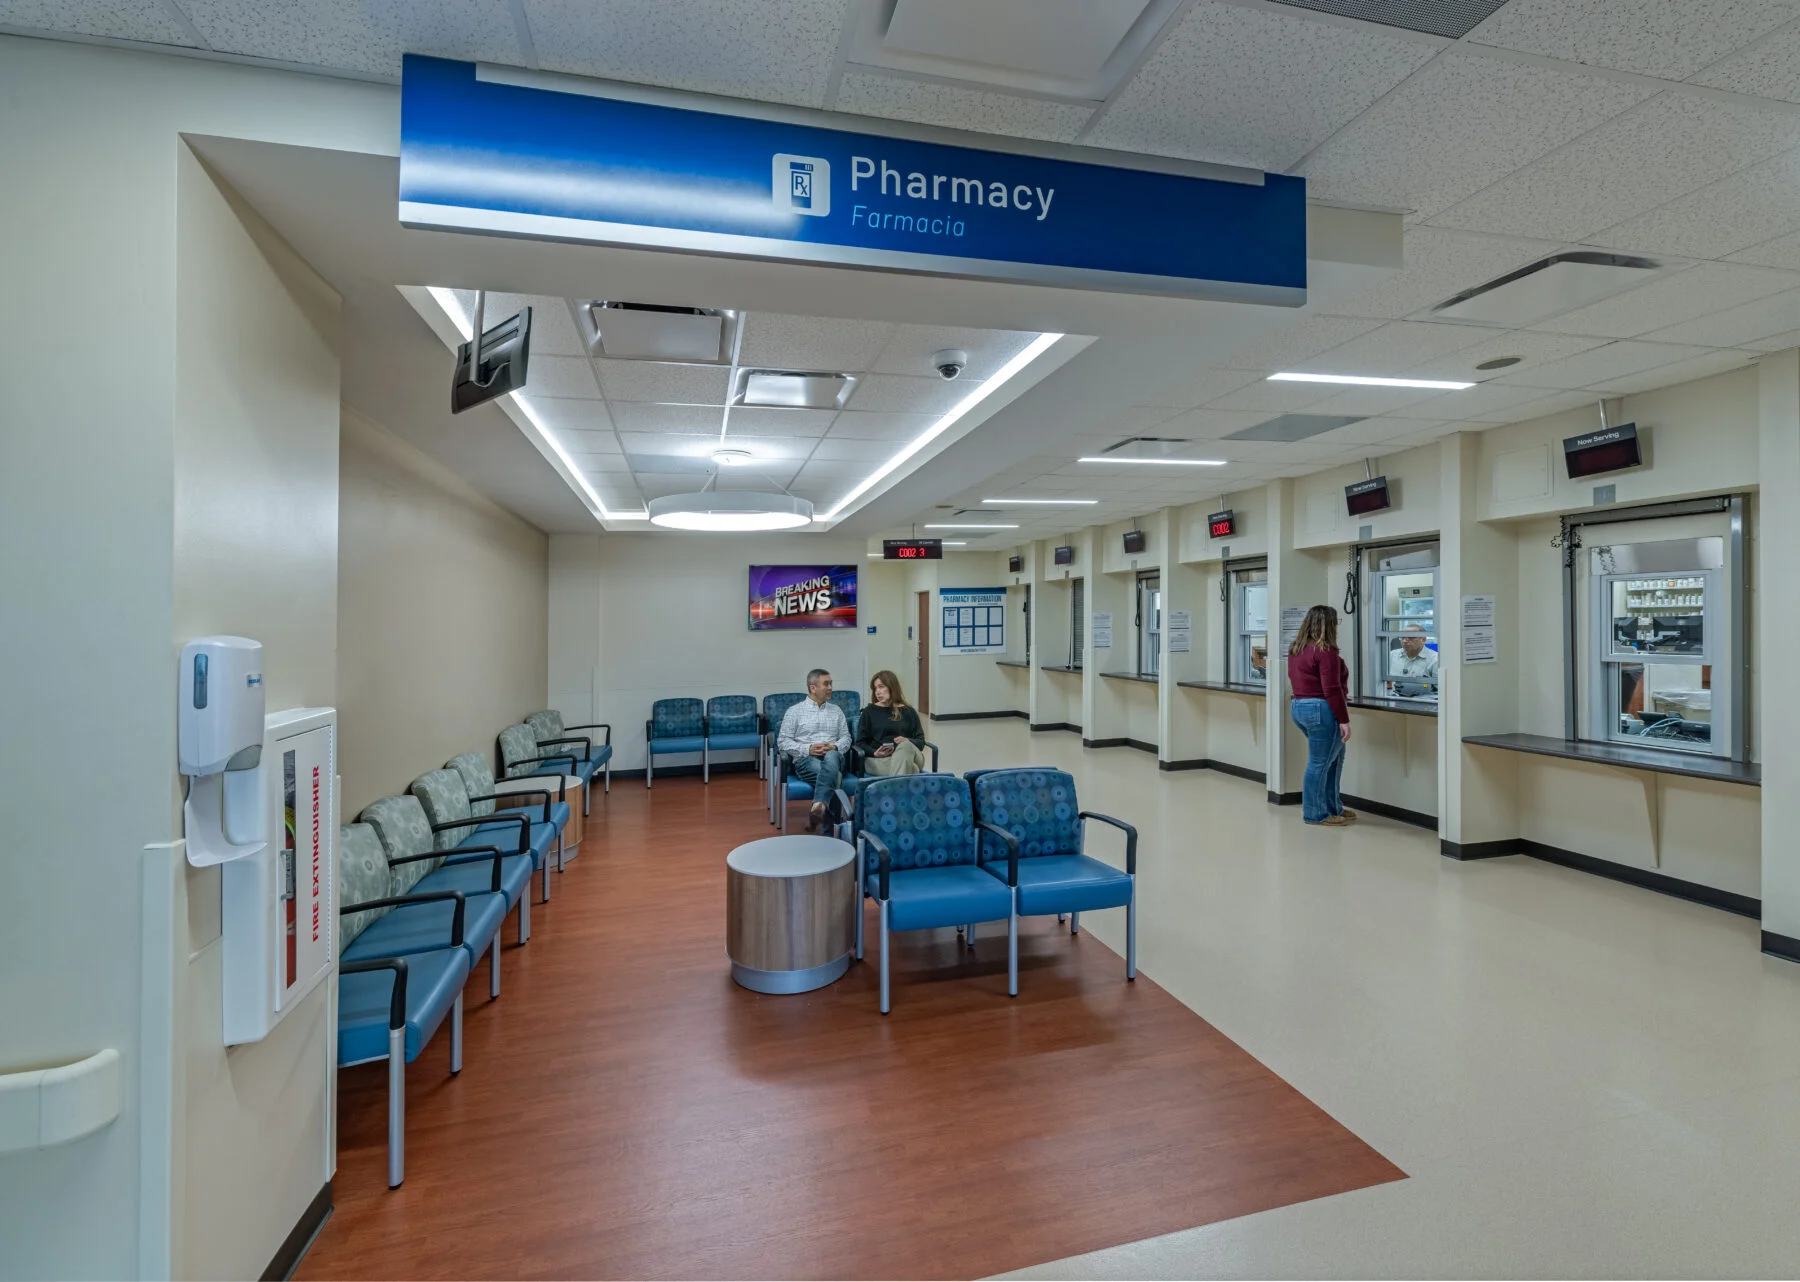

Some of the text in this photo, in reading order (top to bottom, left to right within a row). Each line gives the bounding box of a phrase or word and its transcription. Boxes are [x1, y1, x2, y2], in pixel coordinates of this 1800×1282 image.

[851, 156, 1054, 220] Pharmacy
[851, 205, 965, 236] Farmacia
[1594, 432, 1620, 442] Serving
[919, 547, 925, 557] 3
[775, 575, 830, 597] BREAKING
[774, 589, 831, 616] NEWS
[943, 594, 1002, 603] PHARMACY INFORMATION
[312, 766, 320, 942] FIRE EXTINGUISHER
